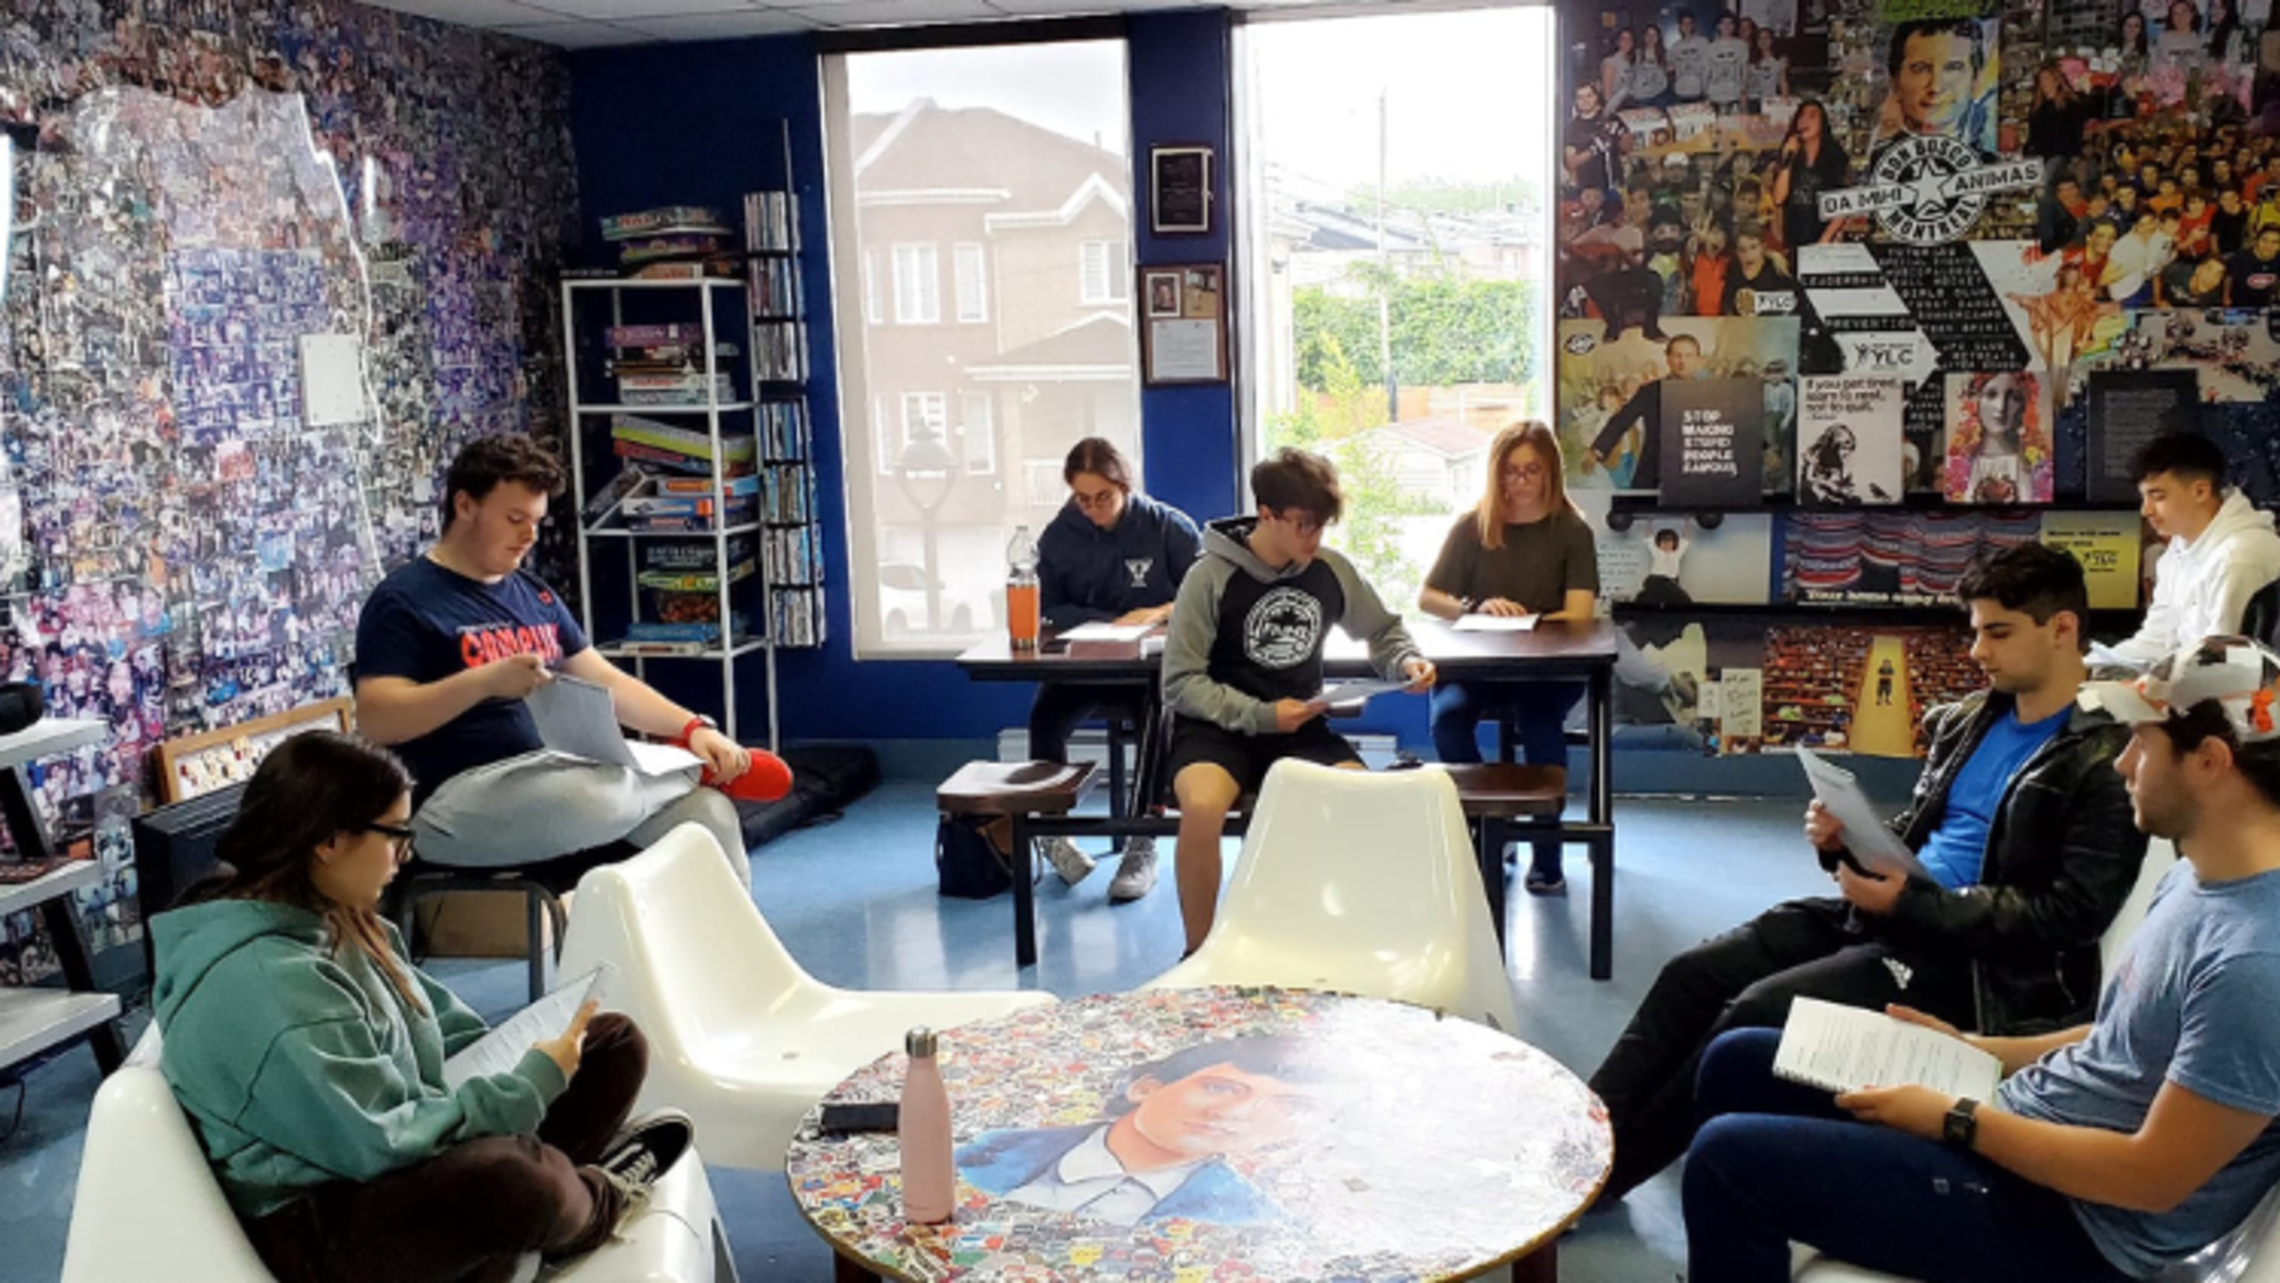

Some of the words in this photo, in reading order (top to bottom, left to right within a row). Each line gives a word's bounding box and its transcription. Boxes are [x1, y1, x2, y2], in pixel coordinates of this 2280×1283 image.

[1914, 138, 1973, 168] BOSCO
[1954, 163, 2040, 193] ANIMAS
[1823, 195, 1853, 214] DA
[1884, 199, 1980, 240] MONTREAL
[1802, 275, 1886, 287] LEADERSHIP
[1825, 318, 1917, 329] PREVENTION
[1870, 349, 1913, 365] YLC
[1815, 381, 1842, 391] you
[1683, 409, 1722, 423] STOP
[1681, 424, 1735, 436] MAKING
[1683, 436, 1732, 448] STUPID
[1682, 449, 1735, 461] PEOPLE
[1806, 588, 1844, 601] Your
[1845, 588, 1890, 602] home
